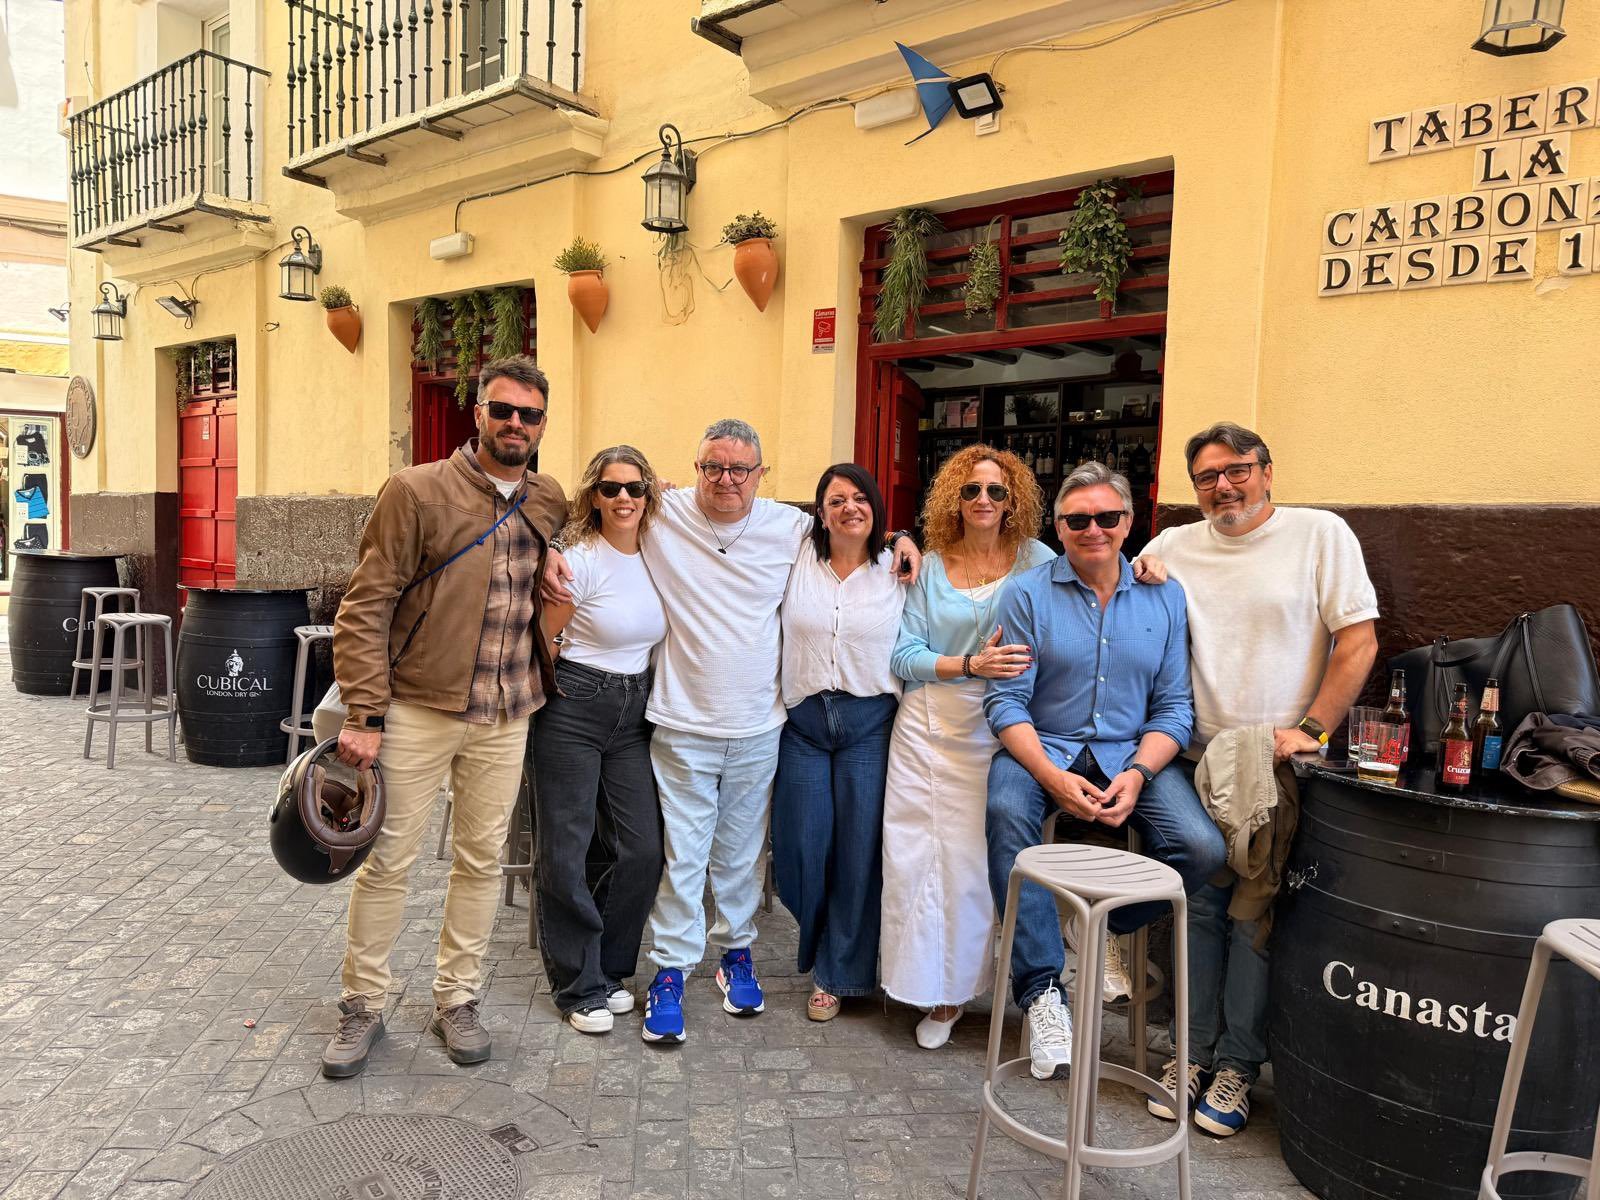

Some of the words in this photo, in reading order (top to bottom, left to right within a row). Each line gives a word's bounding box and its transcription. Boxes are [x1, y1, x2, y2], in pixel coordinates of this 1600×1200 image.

[1374, 86, 1589, 155] TABER
[1481, 139, 1564, 182] LA
[1327, 180, 1600, 247] CARBON
[1320, 237, 1529, 290] DESDE
[1565, 232, 1585, 269] 1
[197, 674, 273, 691] CUBICAL
[1323, 960, 1518, 1043] Canasta
